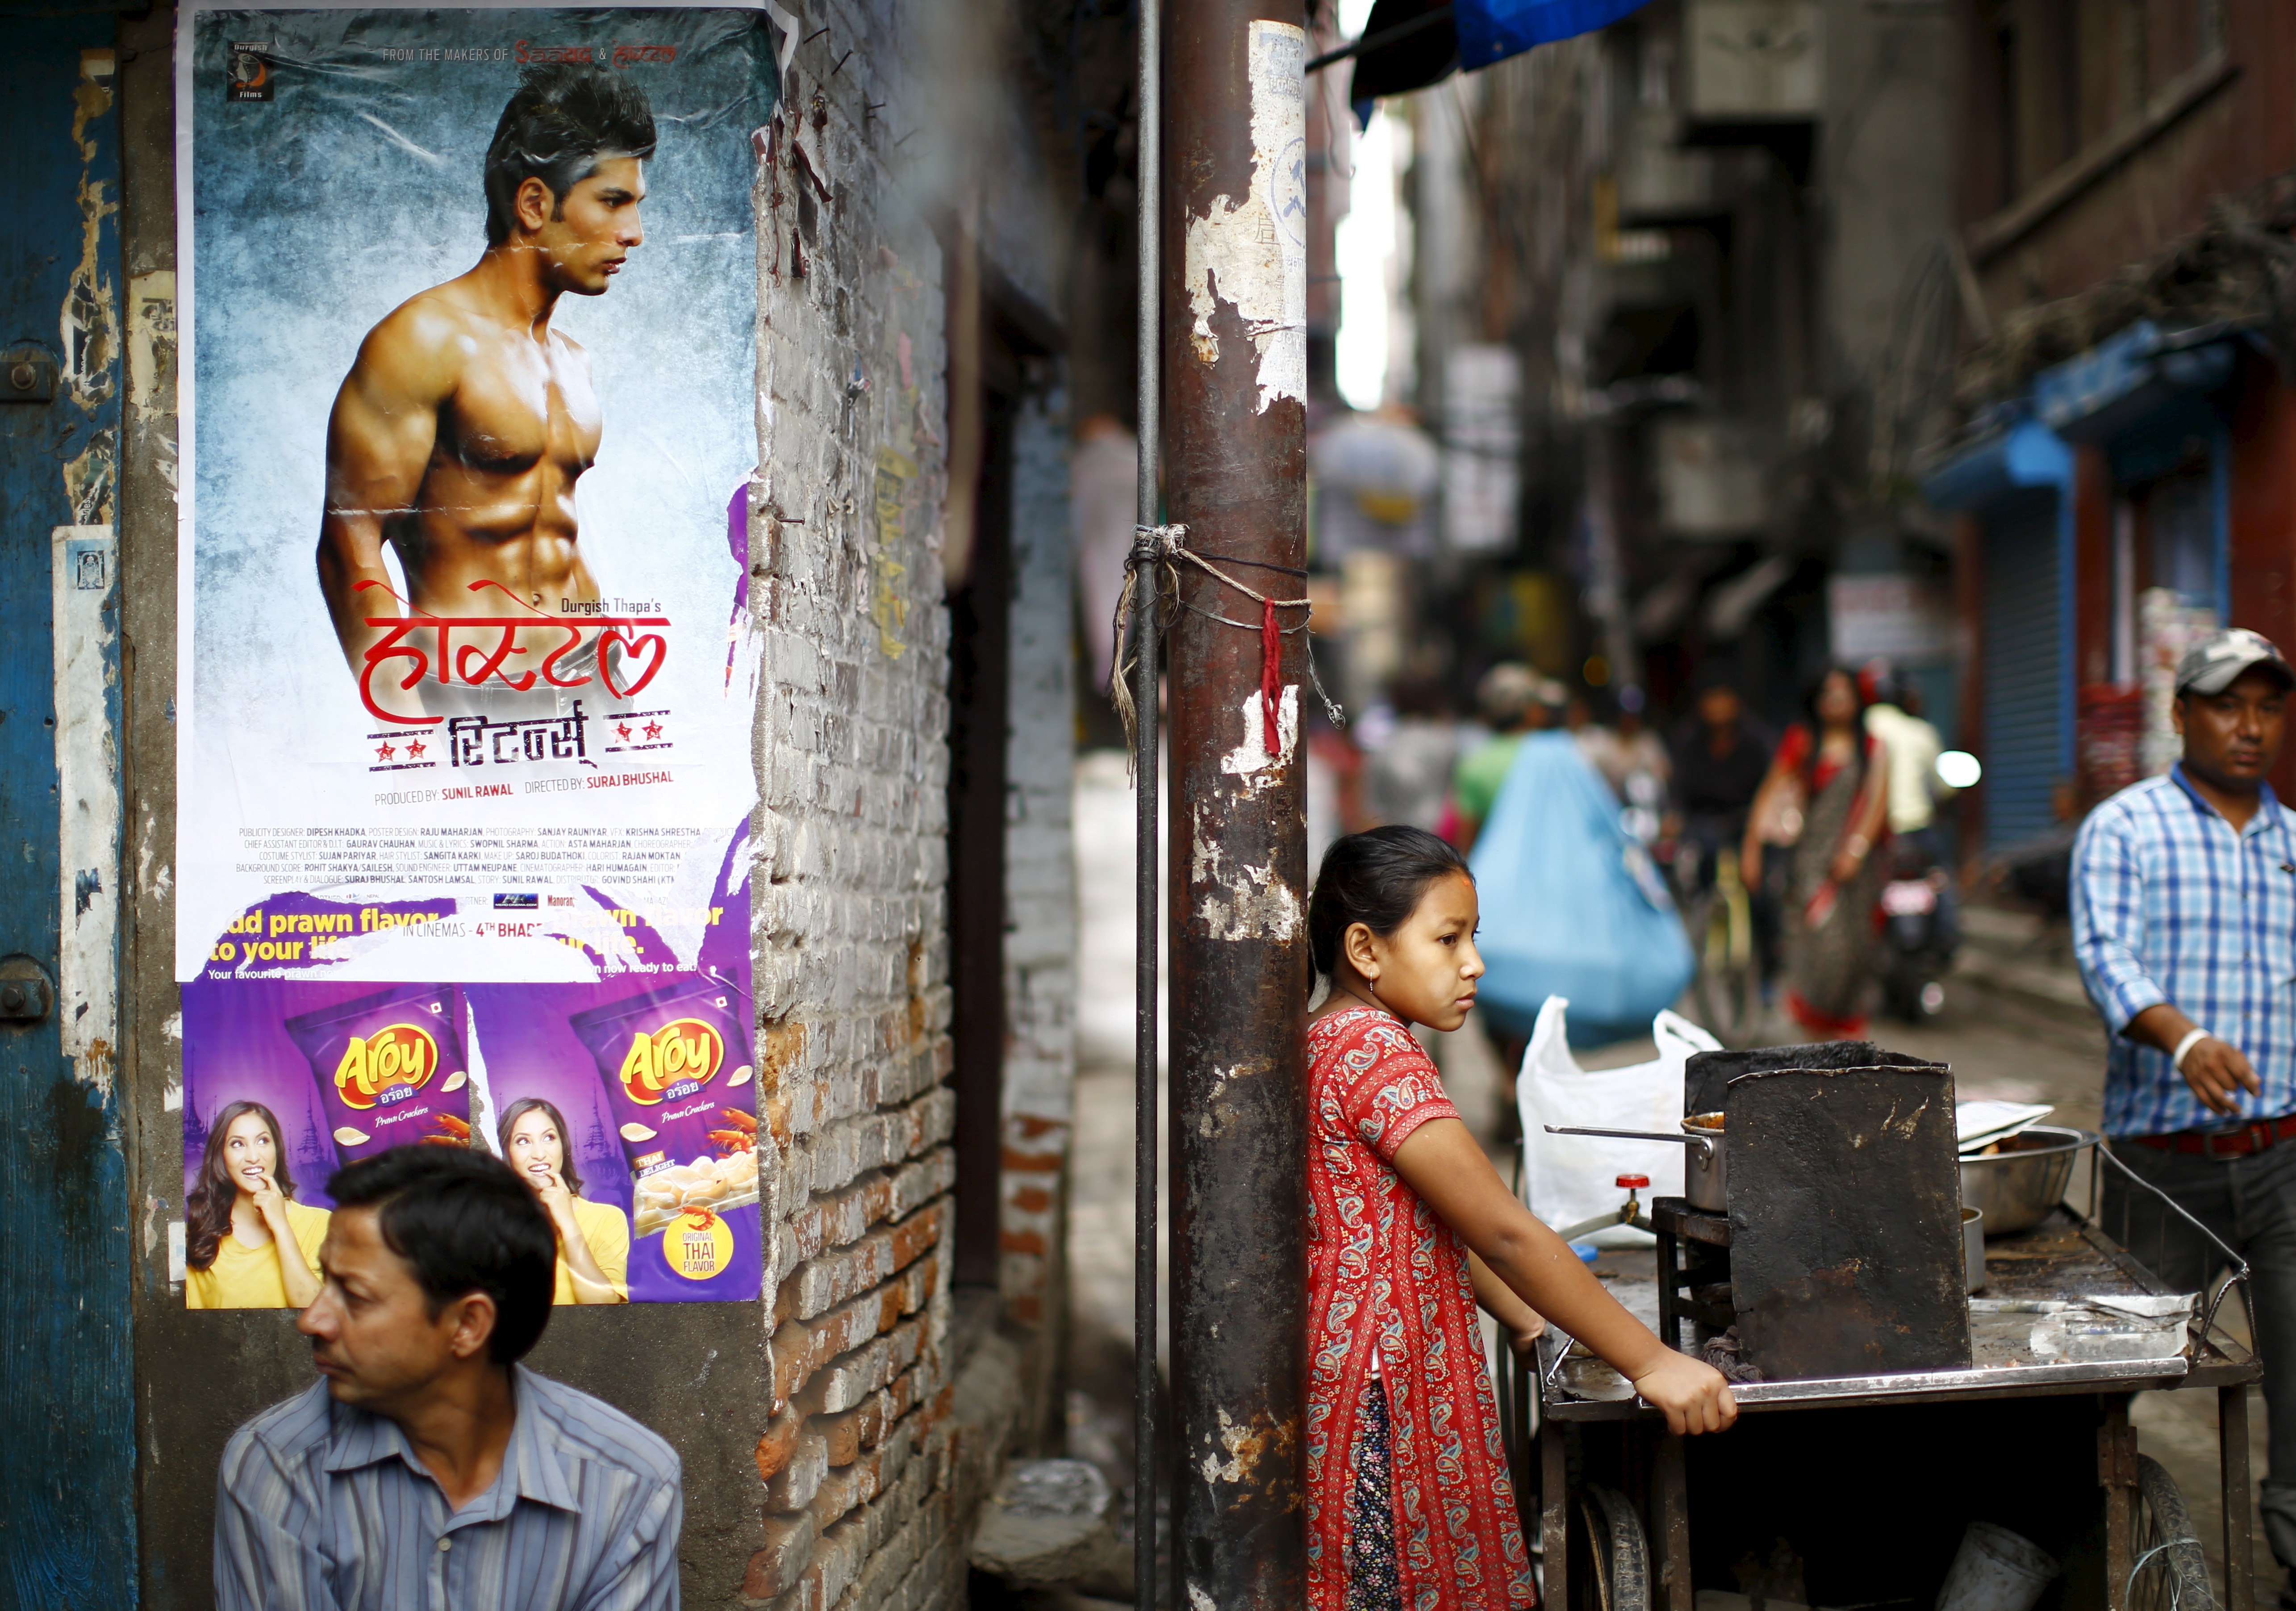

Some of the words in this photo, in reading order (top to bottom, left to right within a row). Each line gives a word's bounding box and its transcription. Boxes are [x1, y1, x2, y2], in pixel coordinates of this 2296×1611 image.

[383, 49, 414, 60] FROM
[419, 49, 440, 60] THE
[444, 49, 489, 60] MAKERS
[494, 49, 508, 60] OF
[599, 48, 606, 60] &
[562, 598, 609, 616] Durgish
[614, 598, 661, 616] Thapa's
[375, 790, 424, 806] PRODUCED
[426, 789, 440, 802] BY:
[442, 787, 474, 800] SUNIL
[475, 783, 513, 797] RAWAL
[525, 778, 569, 794] DIRECTED
[570, 778, 585, 790] BY:
[587, 774, 621, 789] SURAJ
[622, 770, 674, 786] BHUSHAL
[239, 828, 271, 836] PUBLICITY
[272, 828, 305, 836] DESIGNER:
[307, 828, 333, 836] DIPESH
[334, 828, 367, 837] KHADKA,
[369, 828, 393, 836] POSTER
[395, 828, 419, 836] DESIGN:
[420, 828, 439, 836] RAJU
[441, 828, 484, 837] MAHARJAN,
[486, 828, 536, 836] PHOTOGRAPHY:
[538, 828, 566, 836] SANJAY
[568, 828, 609, 837] RAUNIYAR,
[610, 828, 624, 836] VFX:
[626, 828, 660, 836] KRISHNA
[661, 828, 701, 836] SHRESTHA
[245, 840, 262, 848] CHIEF
[263, 840, 297, 848] ASSISTANT
[299, 840, 322, 848] EDITOR
[323, 840, 328, 848] &
[346, 840, 378, 848] GAURAV
[379, 840, 417, 849] CHAUHAN,
[418, 840, 438, 848] MUSIC
[439, 840, 444, 848] &
[445, 840, 469, 848] LYRICS:
[470, 840, 505, 848] SWOPNIL
[506, 840, 540, 849] SHARMA,
[542, 840, 567, 848] ACTION:
[568, 840, 588, 848] ASTA
[589, 840, 633, 849] MAHARJAN,
[259, 852, 289, 860] COSTUME
[291, 852, 317, 860] STYLIST:
[319, 852, 342, 860] SUJAN
[343, 852, 378, 861] PARIYAR,
[380, 852, 394, 860] HAIR
[396, 852, 422, 860] STYLIST:
[424, 852, 456, 860] SANGITA
[458, 852, 483, 861] KARKI,
[484, 852, 502, 860] MAKE
[504, 852, 514, 860] UP:
[516, 852, 539, 860] SAROJ
[541, 852, 587, 861] BUDATHOKI,
[588, 852, 621, 860] COLORIST:
[622, 852, 647, 860] RAJAN
[648, 852, 683, 861] MOKTAN,
[236, 864, 280, 872] BACKGROUND
[281, 864, 303, 872] SCORE:
[305, 864, 327, 872] ROHIT
[396, 864, 417, 872] SOUND
[419, 864, 452, 872] ENGINEER:
[454, 864, 480, 872] UTTAM
[481, 864, 519, 873] NEUPANE,
[520, 864, 585, 872] CINEMATOGRAPHER:
[586, 864, 604, 872] HARI
[650, 864, 675, 872] EDITOR:
[263, 875, 303, 884] SCREENPLAY
[304, 875, 308, 884] &
[310, 875, 344, 884] DIALOGUE:
[345, 875, 369, 884] SURAJ
[408, 875, 443, 884] SANTOSH
[445, 875, 476, 885] LAMSAL,
[478, 875, 501, 884] STORY:
[502, 875, 524, 884] SUNIL
[602, 875, 631, 884] GOVIND
[633, 875, 655, 884] SHAHI
[270, 913, 353, 937] prawn
[403, 925, 414, 937] IN
[417, 923, 465, 937] CINEMAS
[476, 922, 495, 937] 4TH
[209, 941, 236, 961] to
[242, 941, 304, 963] your
[208, 969, 232, 980] Your
[235, 968, 286, 979] favourite
[286, 969, 317, 979] prawn
[604, 965, 627, 974] now
[629, 962, 660, 974] ready
[662, 963, 674, 972] to
[334, 1032, 425, 1096] Aroy
[620, 1027, 710, 1091] Aroy
[380, 1087, 413, 1104] อร่อย
[666, 1081, 699, 1099] อร่อย
[375, 1116, 397, 1128] Prawn
[398, 1105, 429, 1121] Crackers
[662, 1111, 684, 1124] Prawn
[685, 1100, 714, 1117] Crackers
[636, 1153, 663, 1167] THAI
[639, 1159, 675, 1177] DELIGHT
[683, 1233, 714, 1241] ORIGINAL
[683, 1243, 714, 1260] THAI
[684, 1261, 714, 1272] FLAVOR
